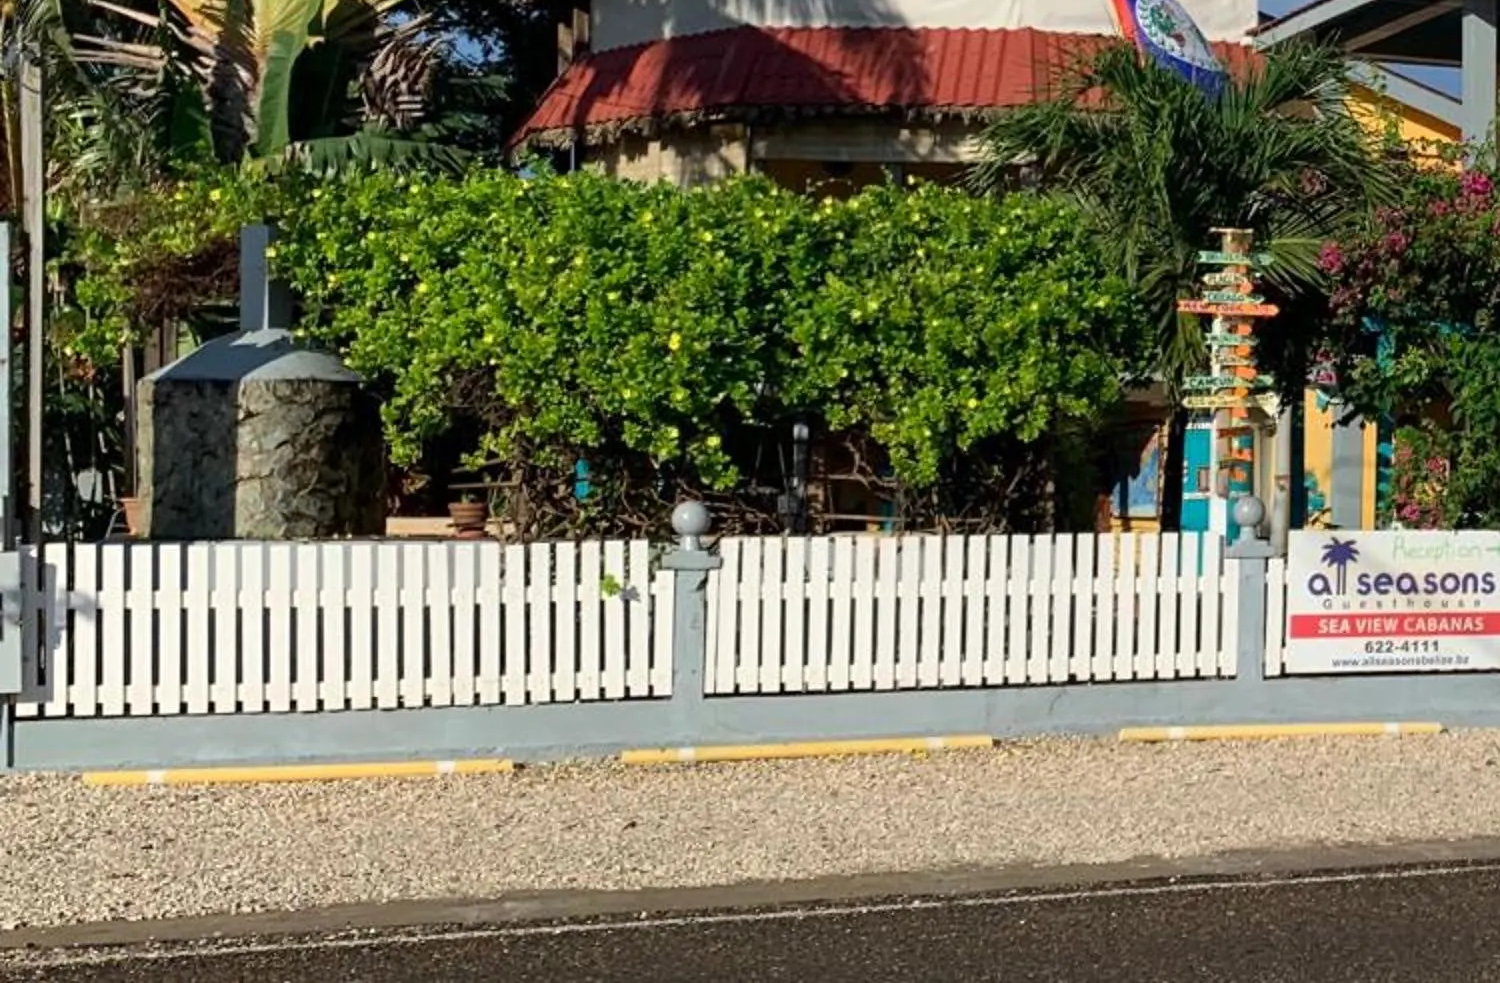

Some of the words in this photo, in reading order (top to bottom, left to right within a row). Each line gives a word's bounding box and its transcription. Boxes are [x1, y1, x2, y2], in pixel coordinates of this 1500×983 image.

[1393, 537, 1481, 564] Reception
[1356, 572, 1496, 596] seasons
[1322, 598, 1481, 610] Guesthouse
[1318, 619, 1350, 634] SEA
[1356, 618, 1398, 633] VIEW
[1403, 616, 1484, 632] CABANAS
[1365, 640, 1440, 654] 622-4111
[1332, 655, 1470, 667] www.allseasonsbelize.bz
